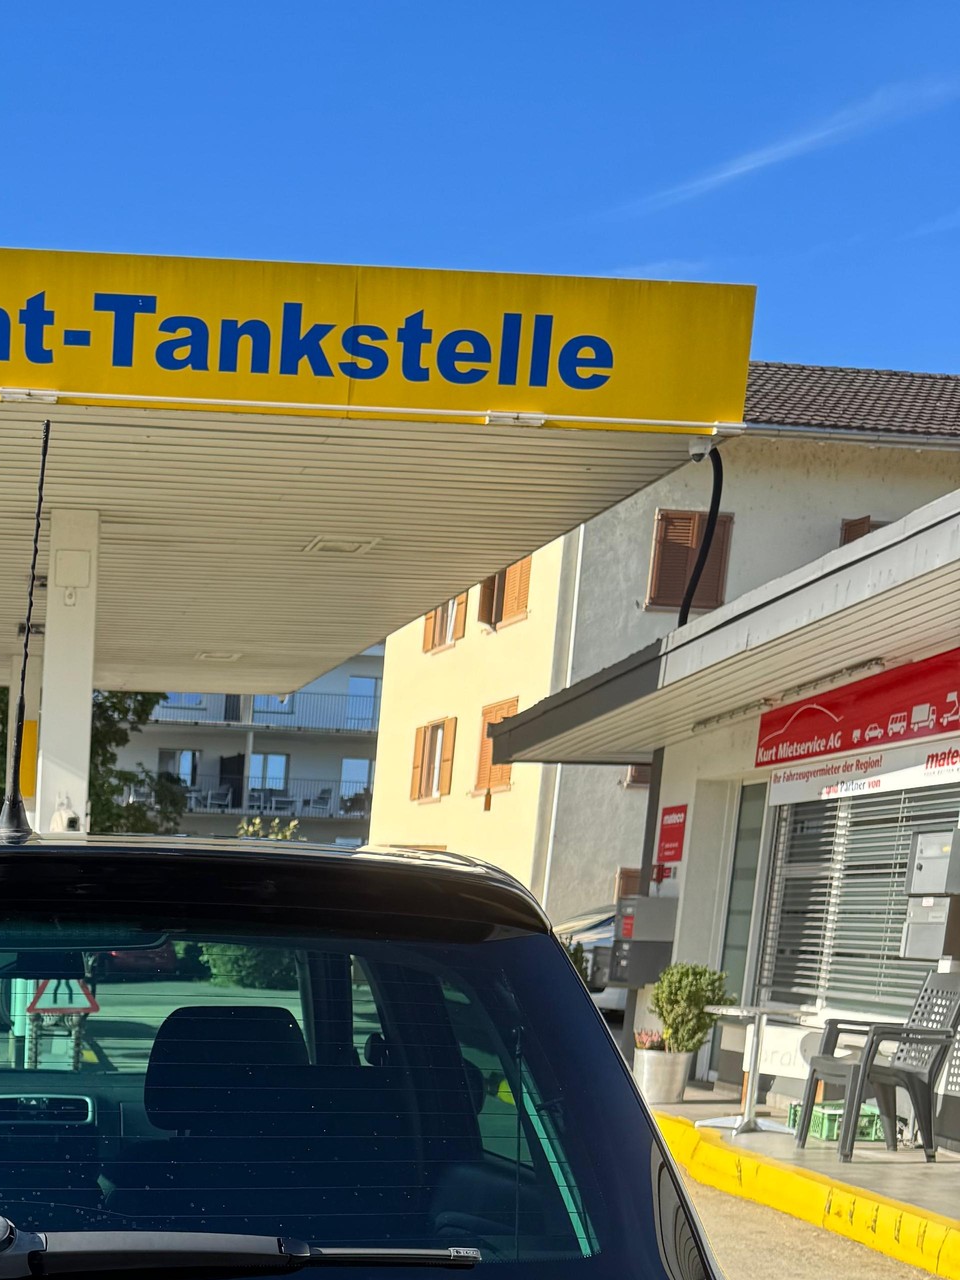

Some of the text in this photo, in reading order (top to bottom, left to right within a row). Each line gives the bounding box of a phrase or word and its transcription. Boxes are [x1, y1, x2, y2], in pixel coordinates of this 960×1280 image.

[757, 731, 842, 763] Kurt Mietservice AG
[925, 747, 960, 770] mate
[782, 763, 841, 783] Fahrzeugvermieter
[842, 760, 853, 773] der
[855, 754, 883, 774] Region!
[840, 779, 865, 793] Partner
[868, 779, 881, 790] von
